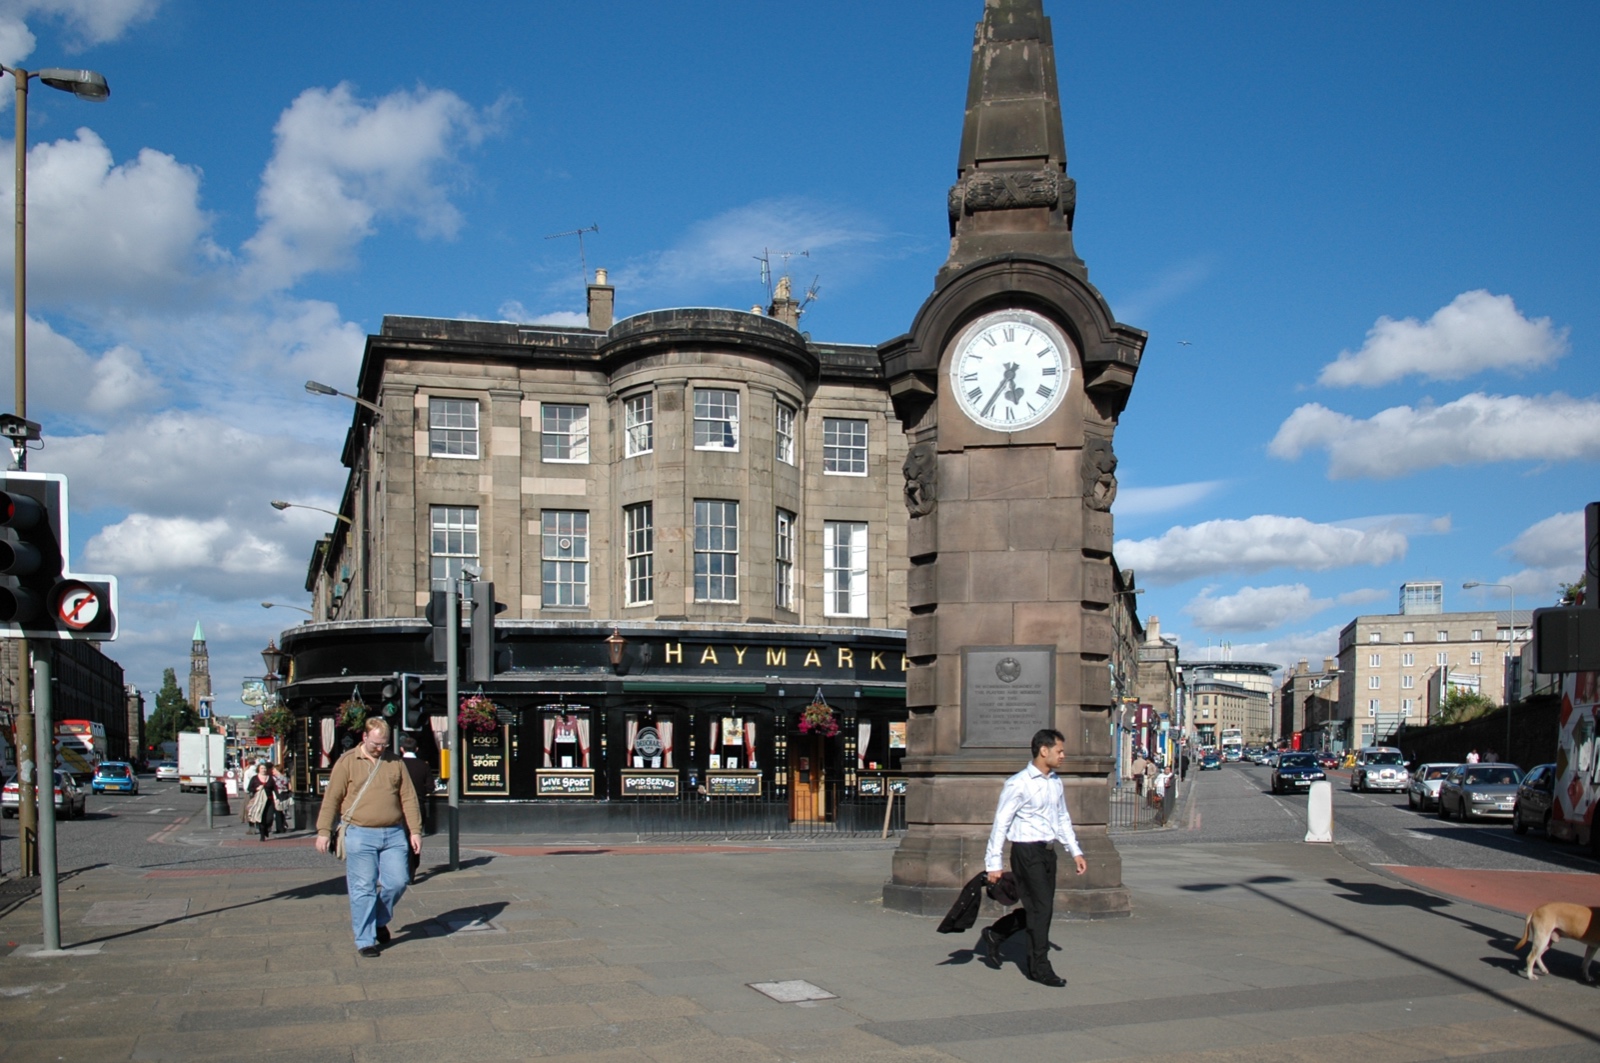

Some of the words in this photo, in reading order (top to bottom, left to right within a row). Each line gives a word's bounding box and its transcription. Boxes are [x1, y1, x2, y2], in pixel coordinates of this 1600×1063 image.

[473, 736, 499, 744] FOOD
[541, 777, 561, 787] LIVE
[562, 777, 590, 788] SPORT
[625, 778, 646, 788] FOOD
[645, 777, 675, 788] SERVED
